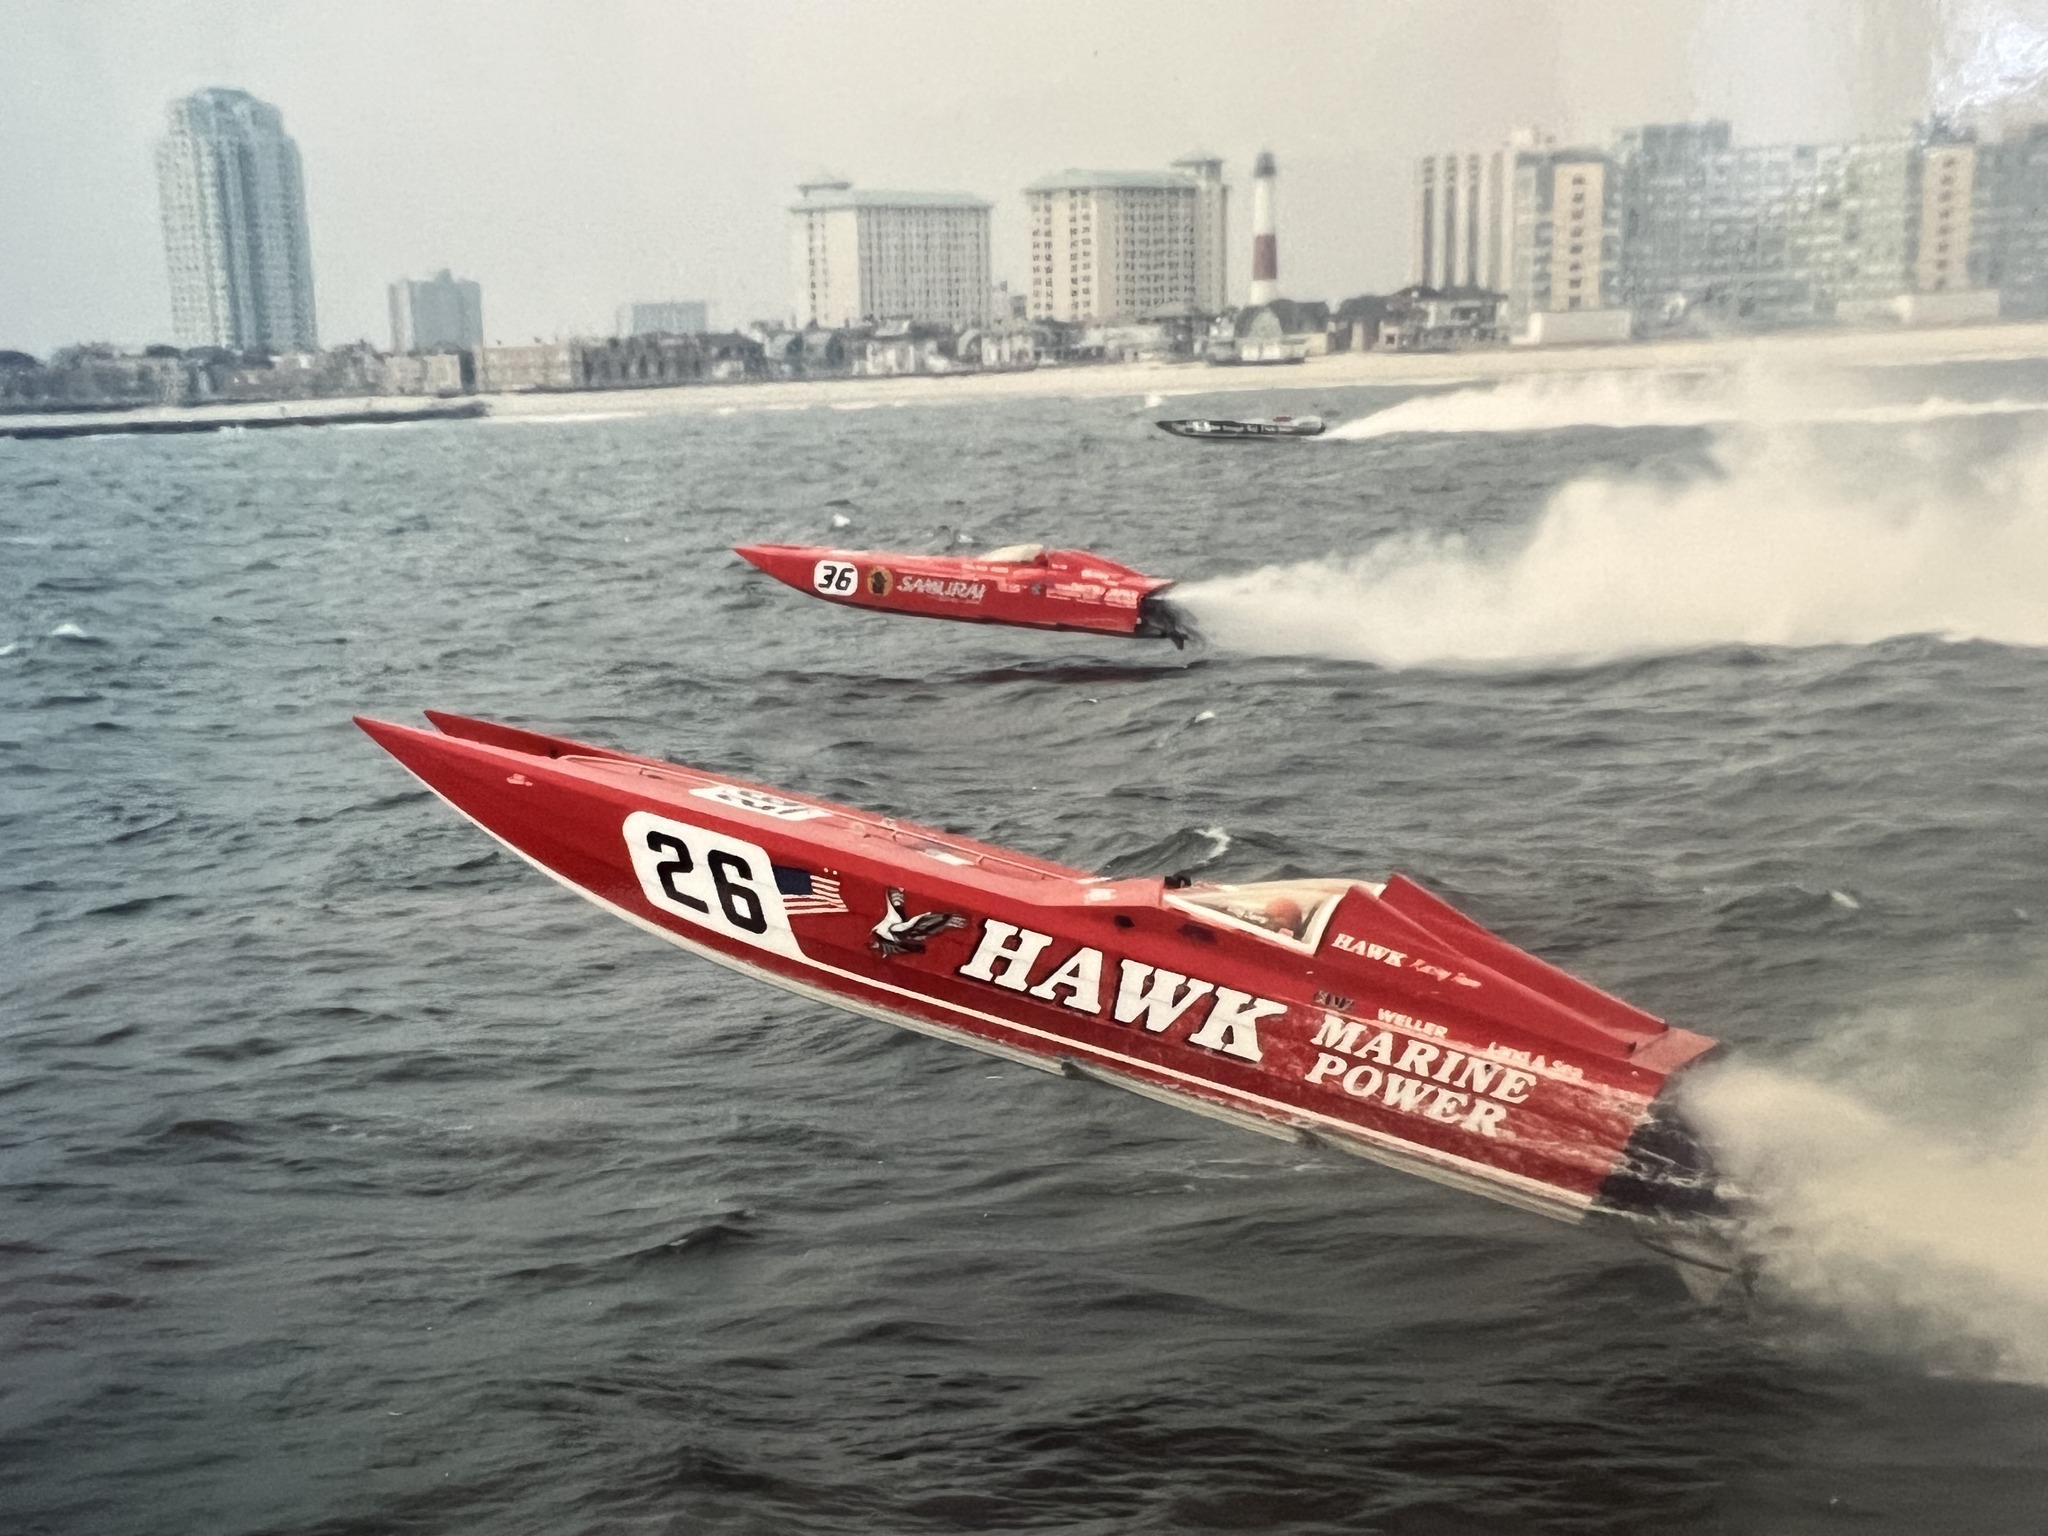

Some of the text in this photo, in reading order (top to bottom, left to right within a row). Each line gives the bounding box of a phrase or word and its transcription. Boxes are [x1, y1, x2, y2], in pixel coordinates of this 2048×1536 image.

[818, 565, 856, 591] 36
[896, 576, 987, 601] SAMURAI
[646, 830, 768, 934] 26
[1331, 933, 1408, 967] HAWK
[959, 918, 1288, 1062] HAWK
[1377, 1008, 1449, 1039] WELLER
[1310, 1014, 1538, 1105] MARINE
[1305, 1052, 1511, 1139] POWER
